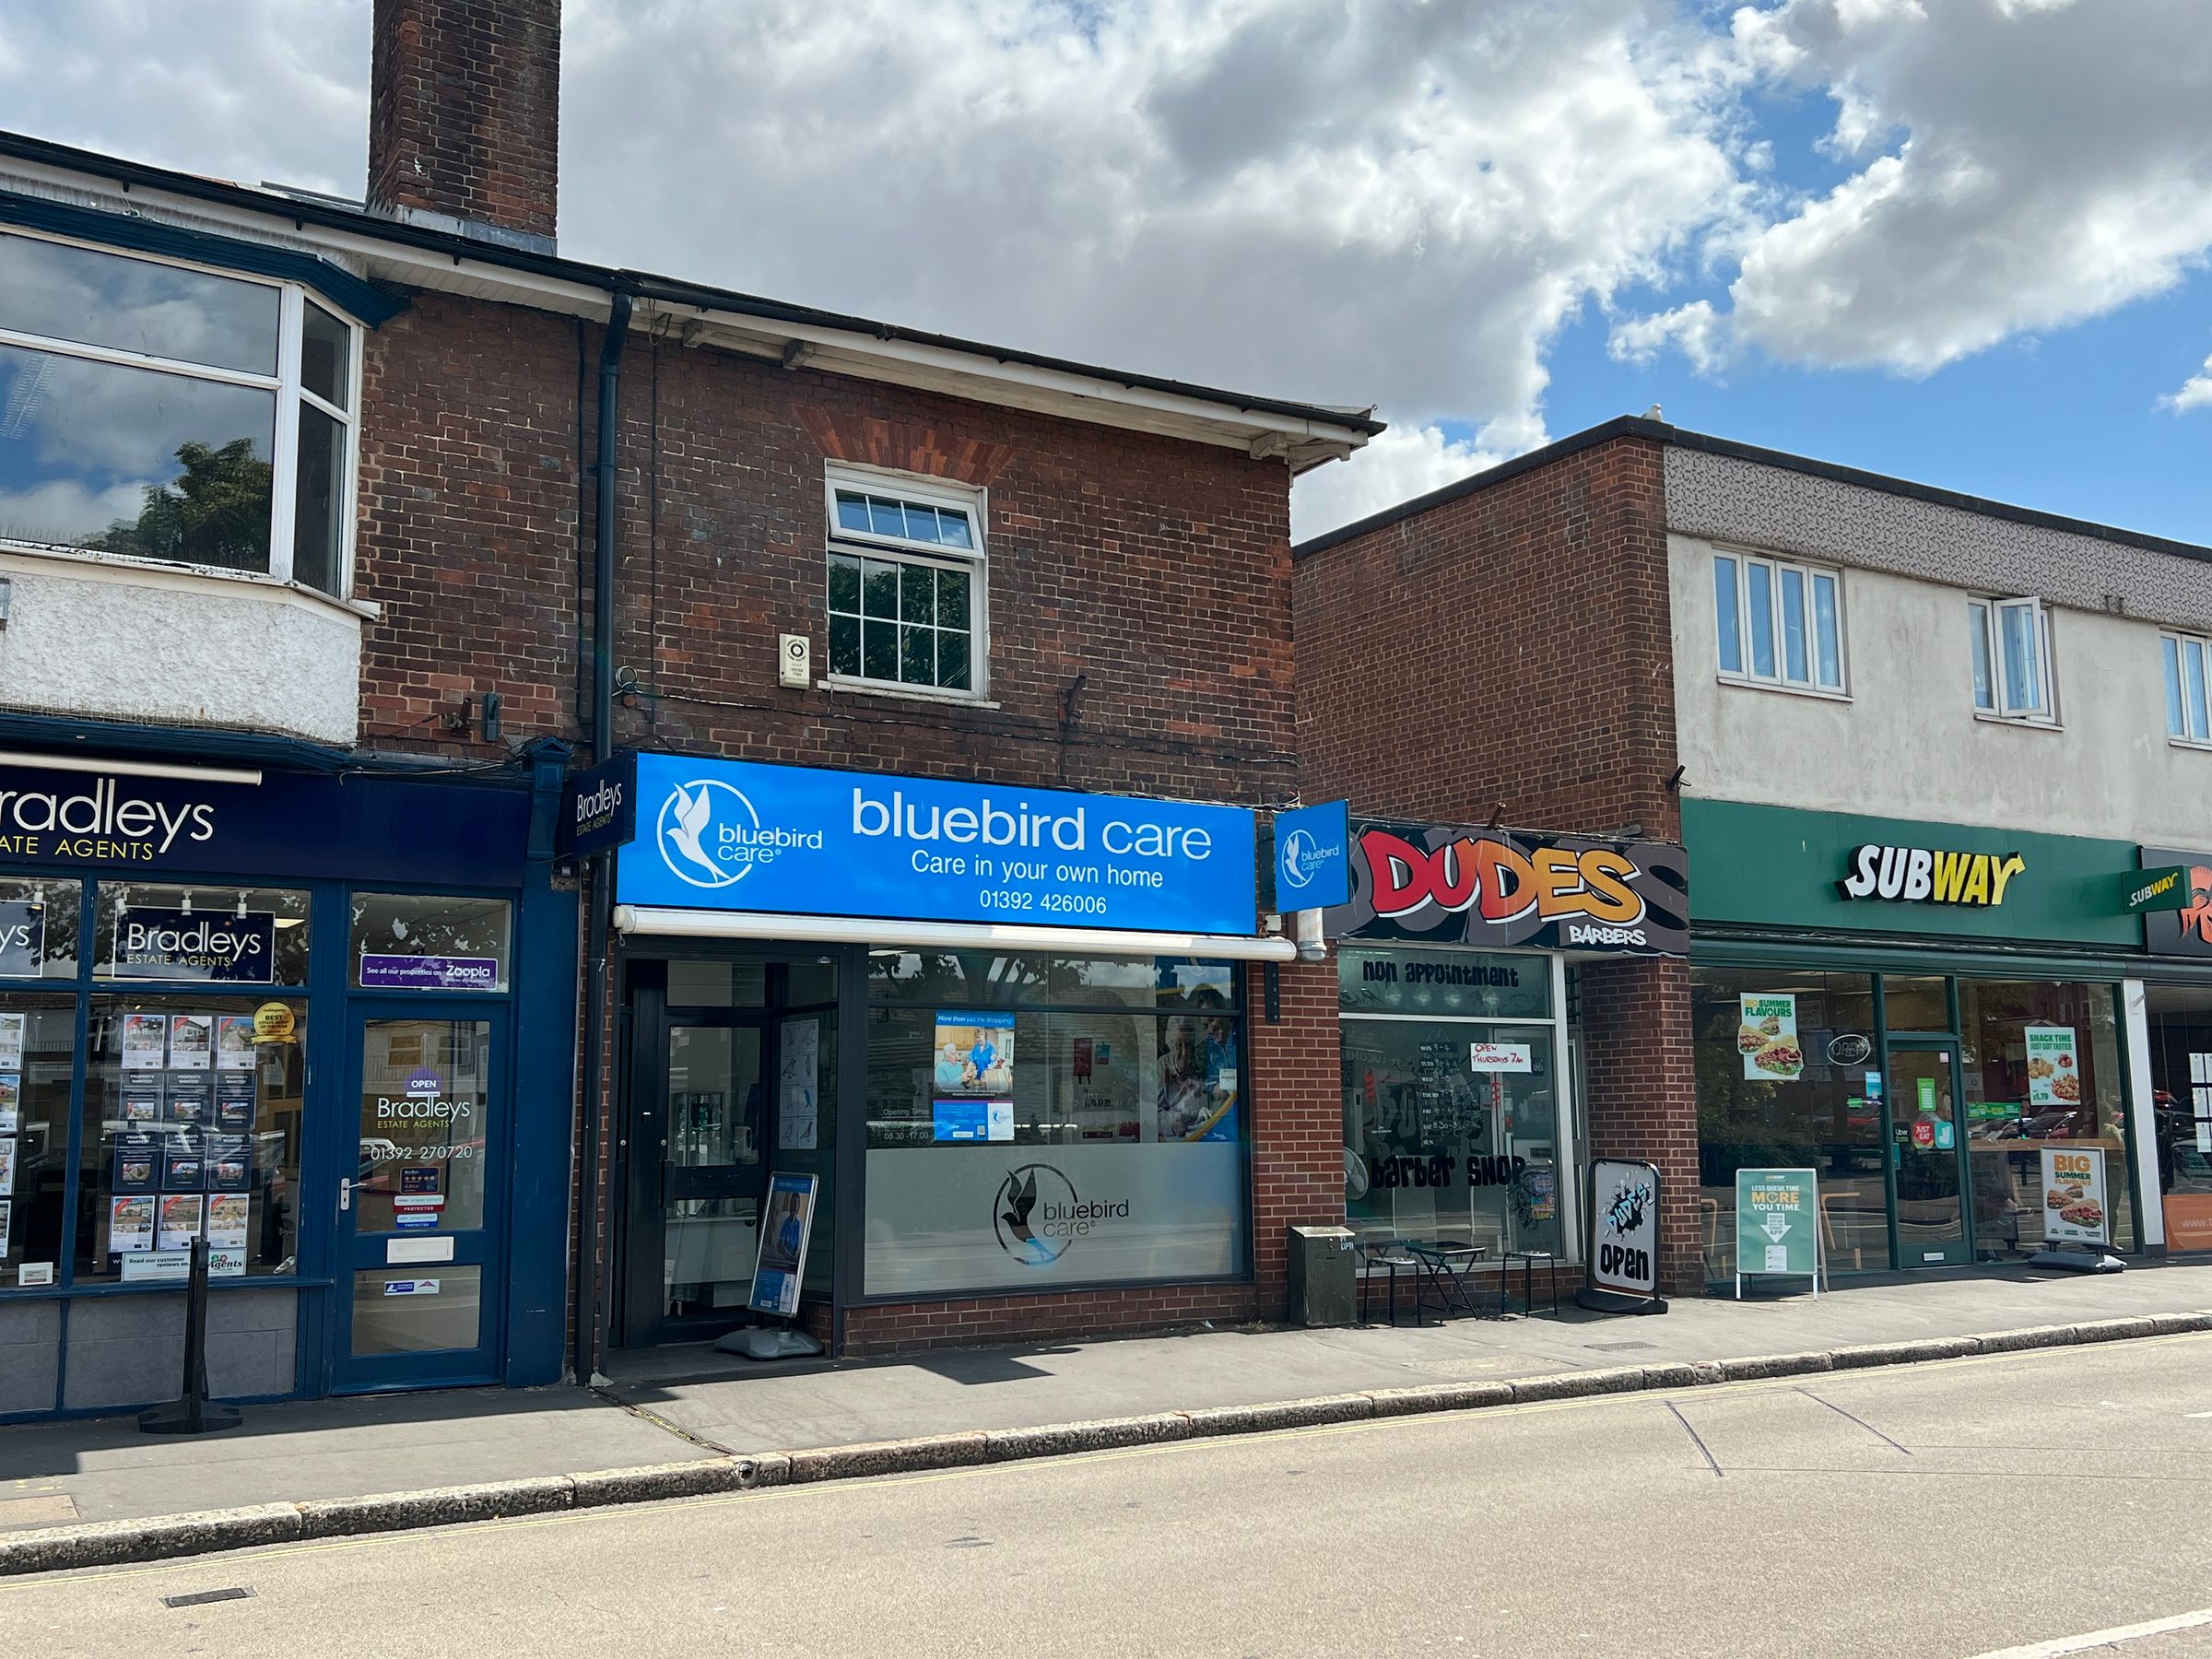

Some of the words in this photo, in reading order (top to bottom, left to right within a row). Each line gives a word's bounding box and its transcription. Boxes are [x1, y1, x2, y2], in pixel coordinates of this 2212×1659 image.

[577, 778, 621, 822] Bradleys
[592, 812, 611, 830] AGENTS
[852, 787, 1086, 851] bluebird
[1101, 820, 1213, 861] care
[718, 822, 823, 850] bluebird
[55, 839, 153, 861] AGENTS
[1301, 844, 1340, 862] bluebird
[911, 849, 966, 875] Care
[975, 853, 993, 877] in
[1001, 859, 1047, 884] your
[1056, 865, 1099, 884] own
[1106, 864, 1163, 888] home
[1844, 844, 2026, 907] SUBWAY
[1359, 830, 1646, 927] DUDES
[2129, 872, 2179, 907] SUBWAY
[980, 889, 1033, 911] 01392
[1040, 892, 1106, 914] 426006
[127, 922, 262, 962] Bradleys
[1570, 924, 1647, 946] BARBERS
[127, 953, 171, 966] ESTATE
[179, 955, 230, 967] AGENTS
[399, 968, 433, 977] properties
[446, 965, 490, 979] Zoopla
[1362, 960, 1397, 982] non
[1405, 962, 1519, 988] appointment
[1745, 1007, 1792, 1018] FLAVOURS
[1759, 999, 1792, 1008] SUMMER
[2030, 1034, 2053, 1042] SNACK
[2053, 1034, 2072, 1042] TIME
[1475, 1043, 1497, 1053] OPEN
[1472, 1053, 1509, 1064] THURSDAYS
[411, 1080, 437, 1088] OPEN
[377, 1096, 470, 1123] Bradleys
[883, 1108, 910, 1117] Opening
[911, 1108, 930, 1116] Times
[377, 1120, 407, 1128] ESTATE
[413, 1119, 450, 1128] AGENTS
[371, 1147, 413, 1160] 01392
[419, 1146, 473, 1159] 270720
[1371, 1155, 1455, 1189] barber
[1466, 1155, 1525, 1186] SHOP
[2053, 1154, 2091, 1172] BIG
[2054, 1171, 2091, 1180] SUMMER
[2054, 1178, 2092, 1186] FLAVOURS
[1751, 1191, 1800, 1204] MORE
[1043, 1198, 1130, 1221] bluebird
[1606, 1183, 1648, 1235] DUDES
